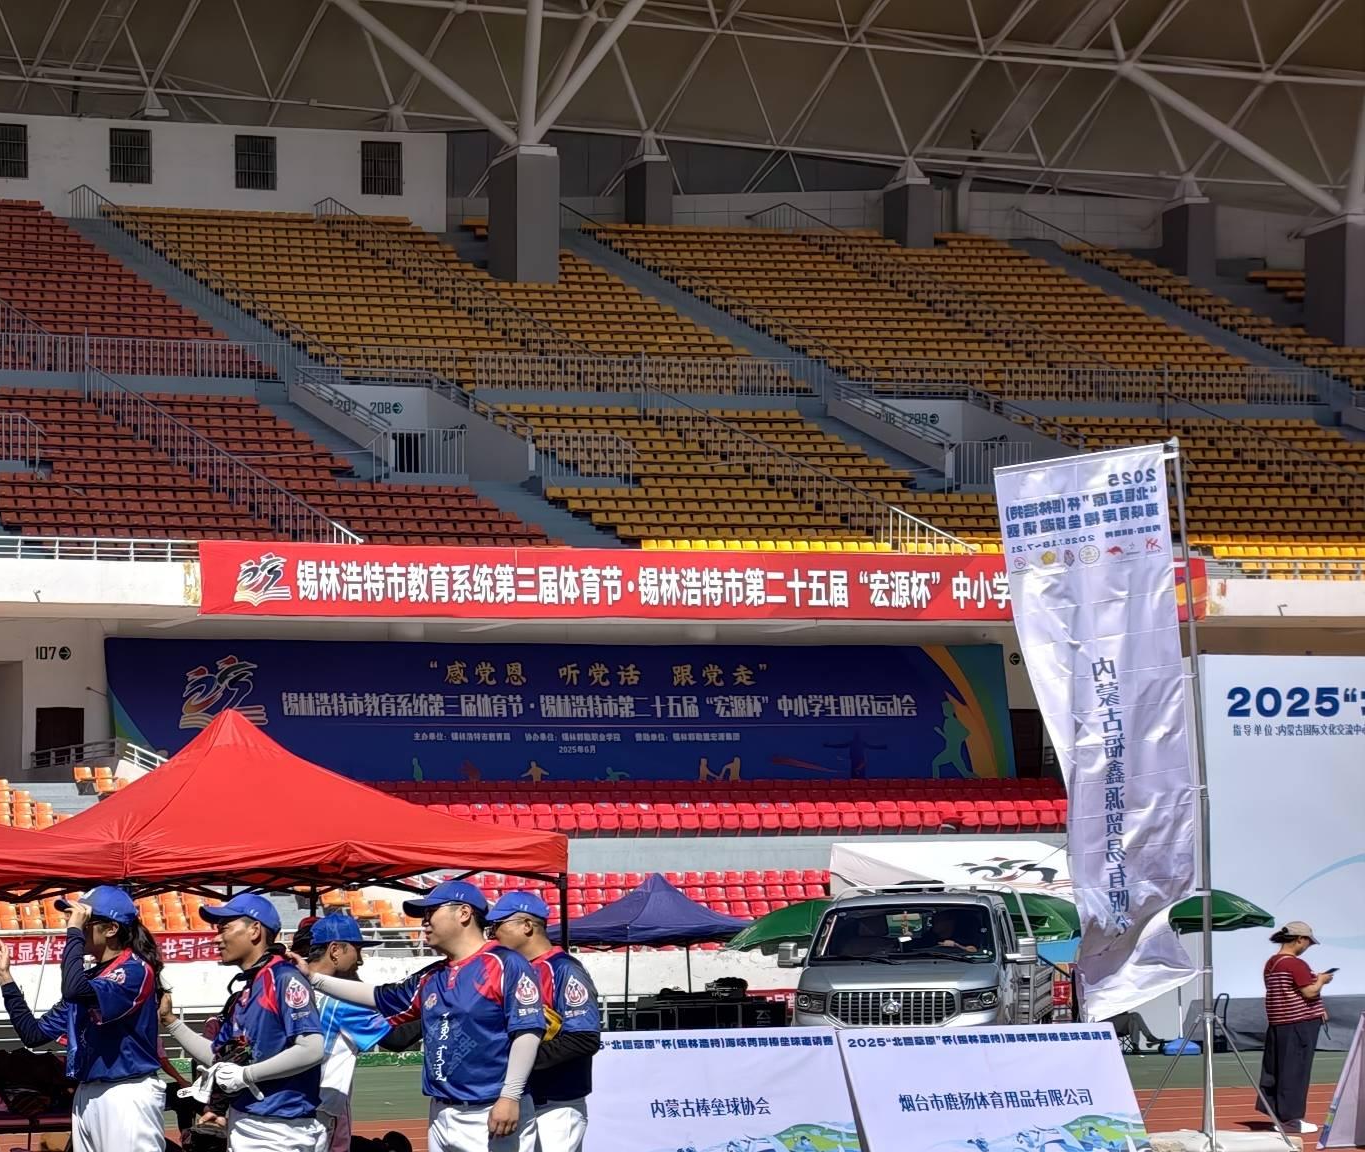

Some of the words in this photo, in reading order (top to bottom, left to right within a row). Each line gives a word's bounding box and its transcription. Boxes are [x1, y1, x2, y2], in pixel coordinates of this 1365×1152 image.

[858, 570, 942, 609] “宏源杯”
[35, 646, 57, 661] 107
[558, 663, 642, 686] 听党话
[650, 1096, 772, 1119] 内蒙古棒垒球协会
[899, 1088, 1094, 1112] 烟台市鹿扬体育用品有限公司
